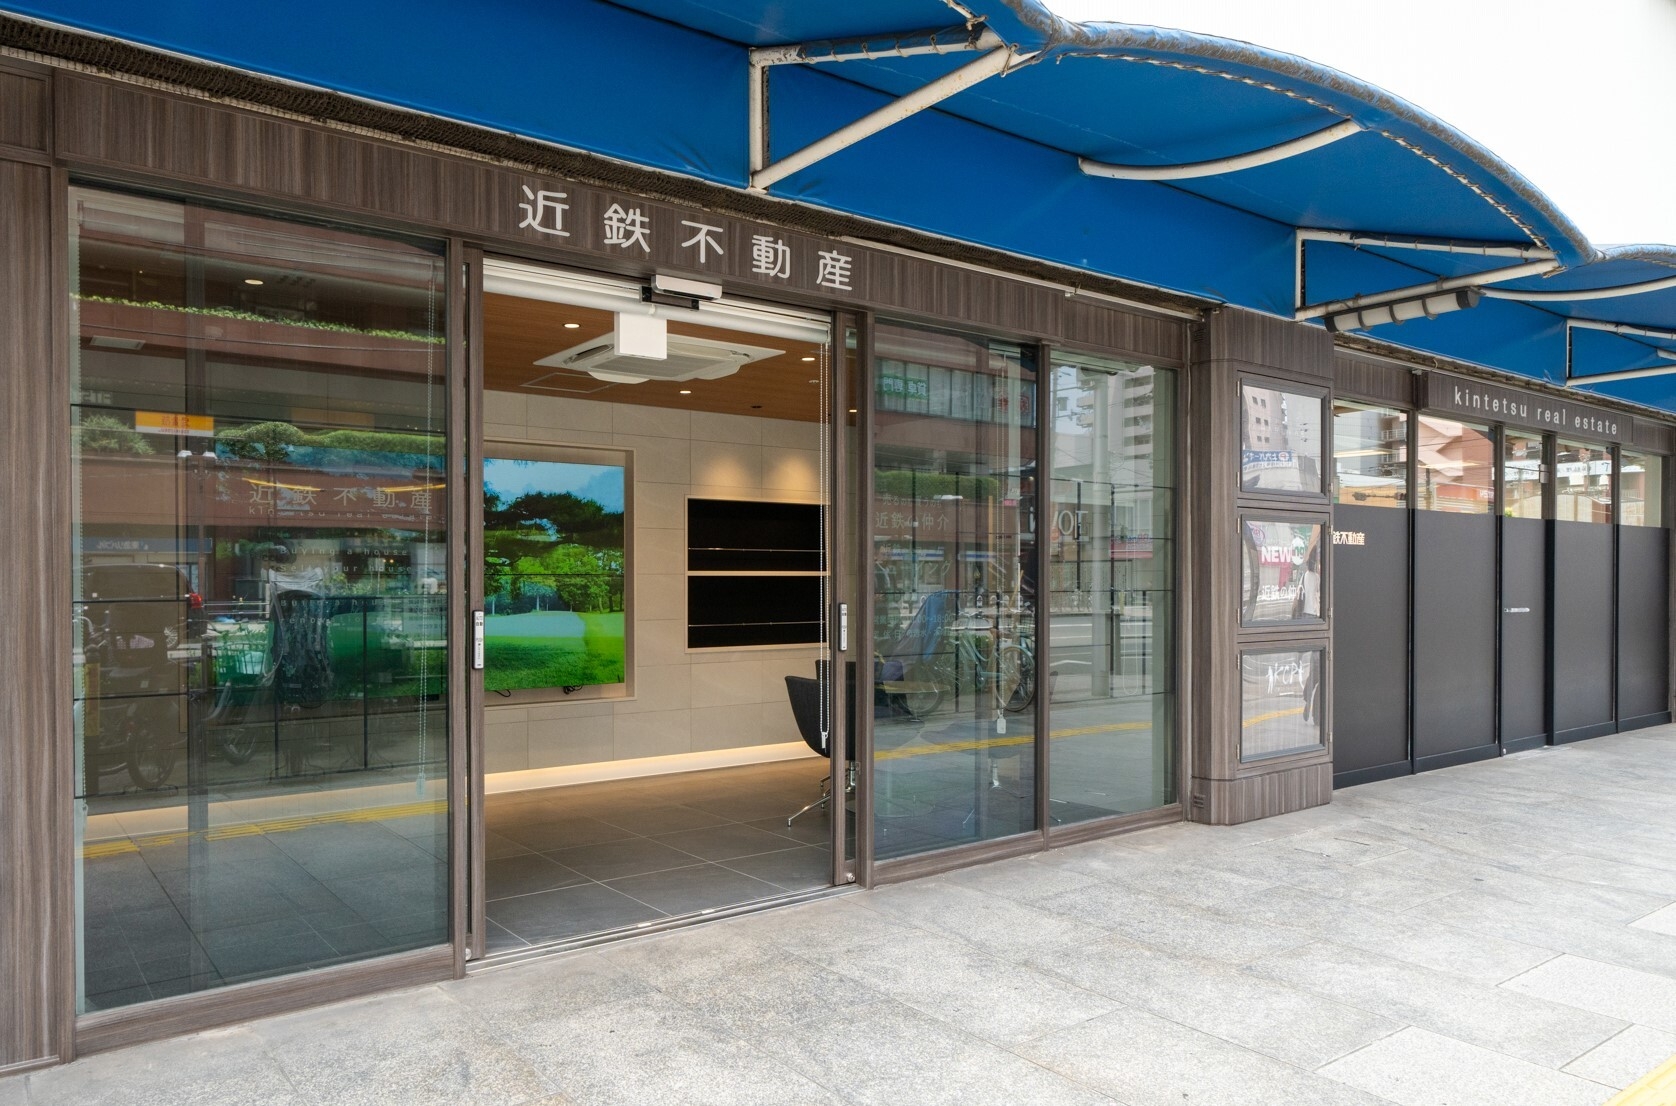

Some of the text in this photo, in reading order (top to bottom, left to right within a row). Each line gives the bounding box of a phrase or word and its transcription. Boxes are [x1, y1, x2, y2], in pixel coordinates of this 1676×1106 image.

[518, 184, 853, 291] 近鉄不動産
[1454, 386, 1617, 435] kintetsu real estate
[249, 483, 433, 510] 近鉄不動産
